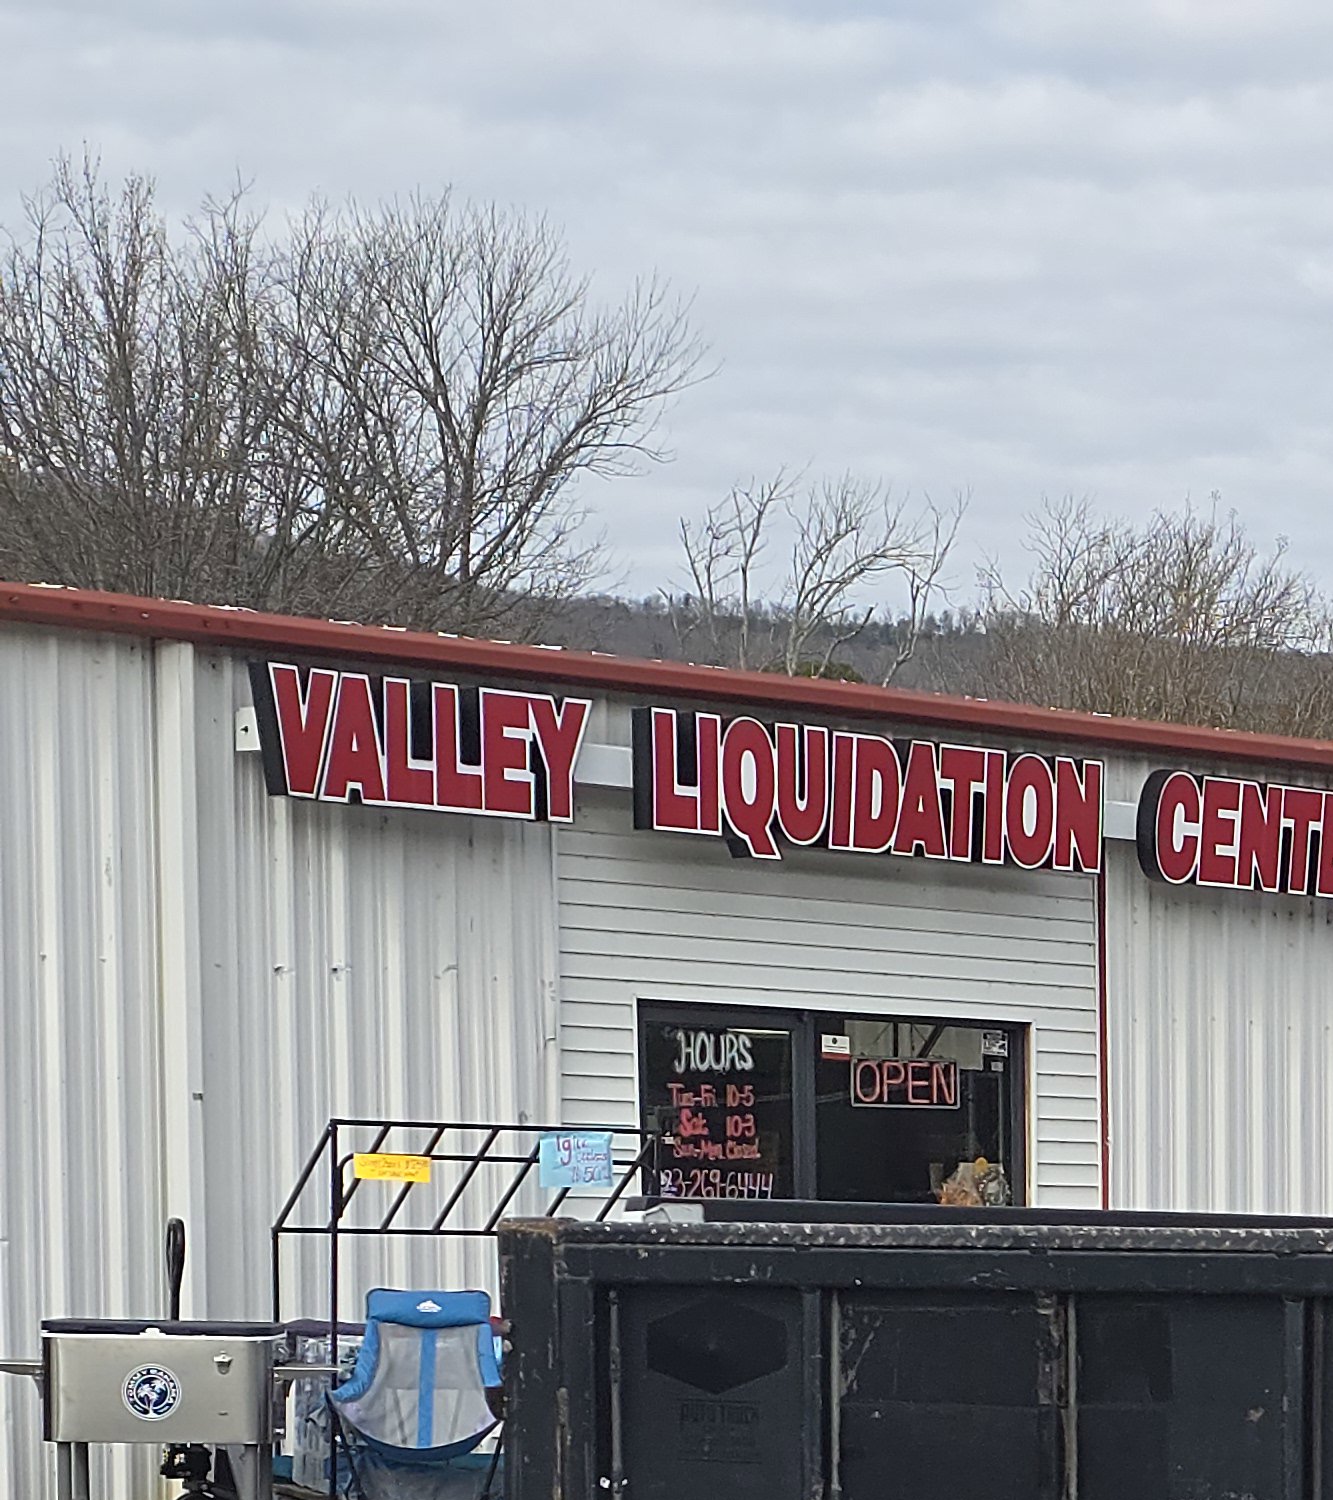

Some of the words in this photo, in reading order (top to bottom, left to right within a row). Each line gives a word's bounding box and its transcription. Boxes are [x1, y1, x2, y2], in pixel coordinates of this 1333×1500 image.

[264, 661, 593, 824] VALLEY
[648, 705, 1105, 876] LIQUIDATION
[673, 1029, 756, 1074] HOURS
[854, 1060, 957, 1105] OPEN
